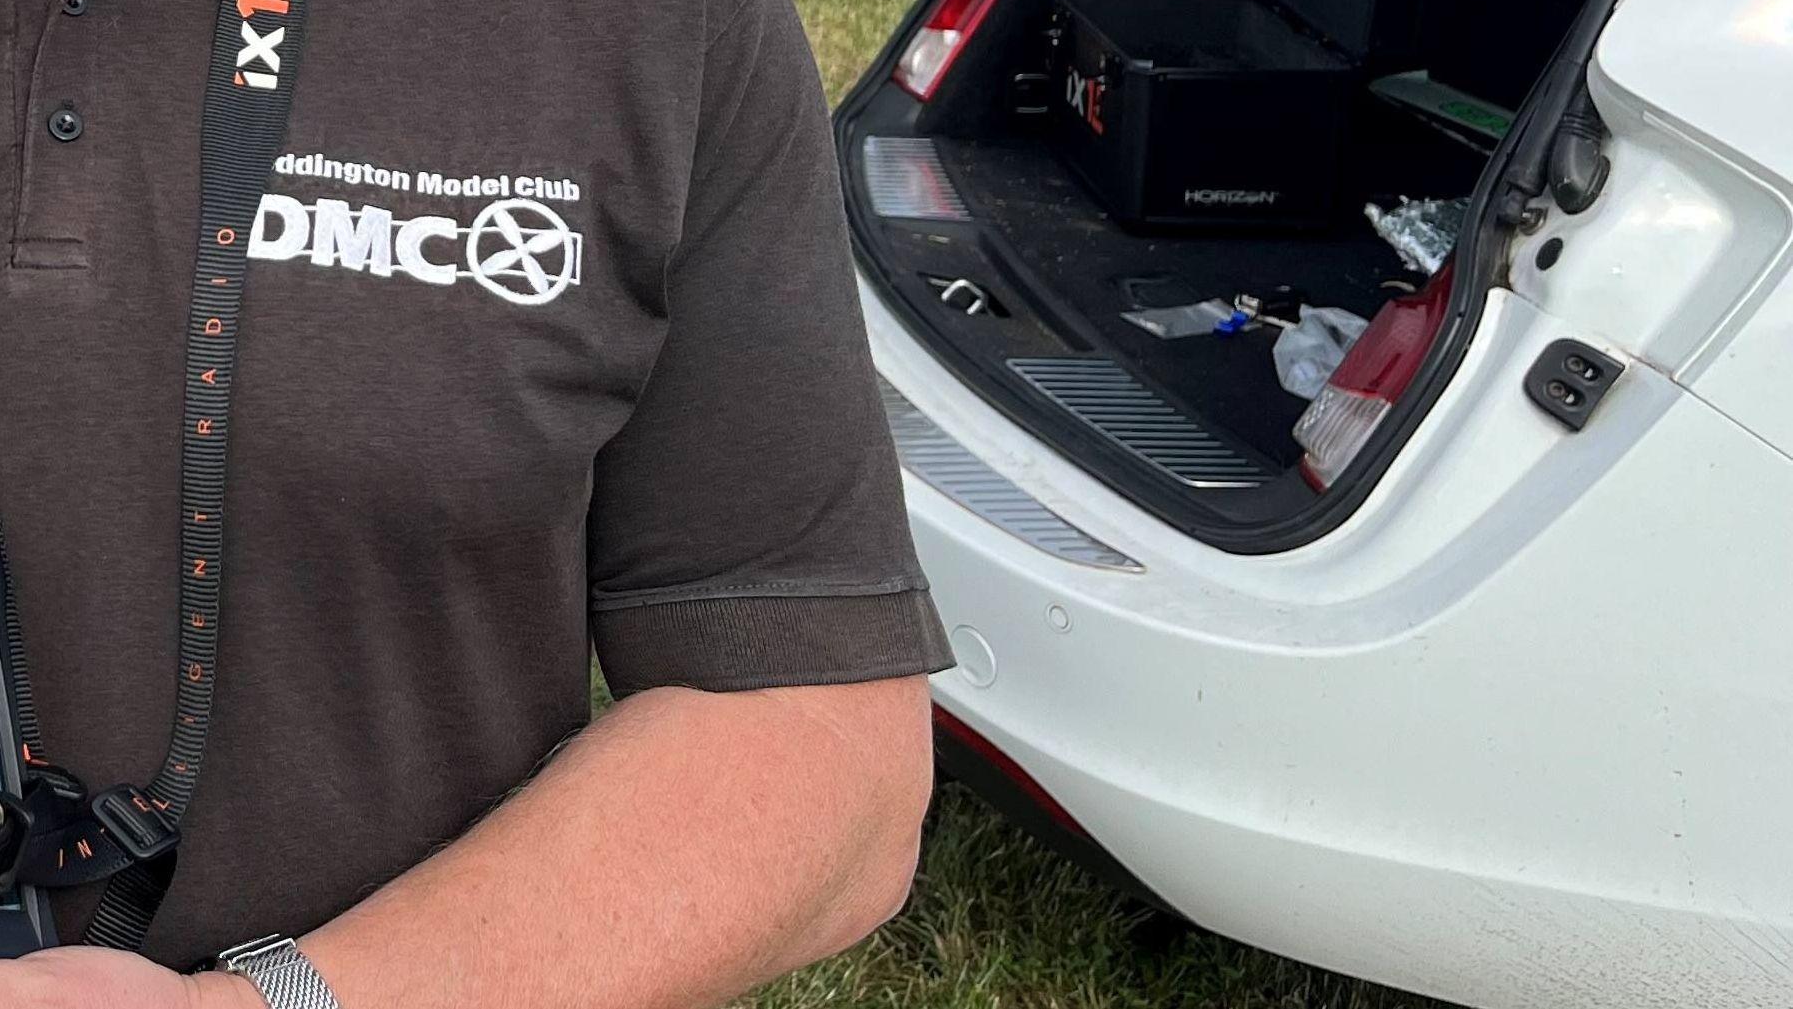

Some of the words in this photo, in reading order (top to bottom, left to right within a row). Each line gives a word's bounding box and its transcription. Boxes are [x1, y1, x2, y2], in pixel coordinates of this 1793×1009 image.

[272, 153, 410, 191] ddington
[417, 171, 508, 197] Model
[514, 176, 581, 202] Club
[247, 193, 458, 285] DMC
[196, 228, 236, 435] RADIO
